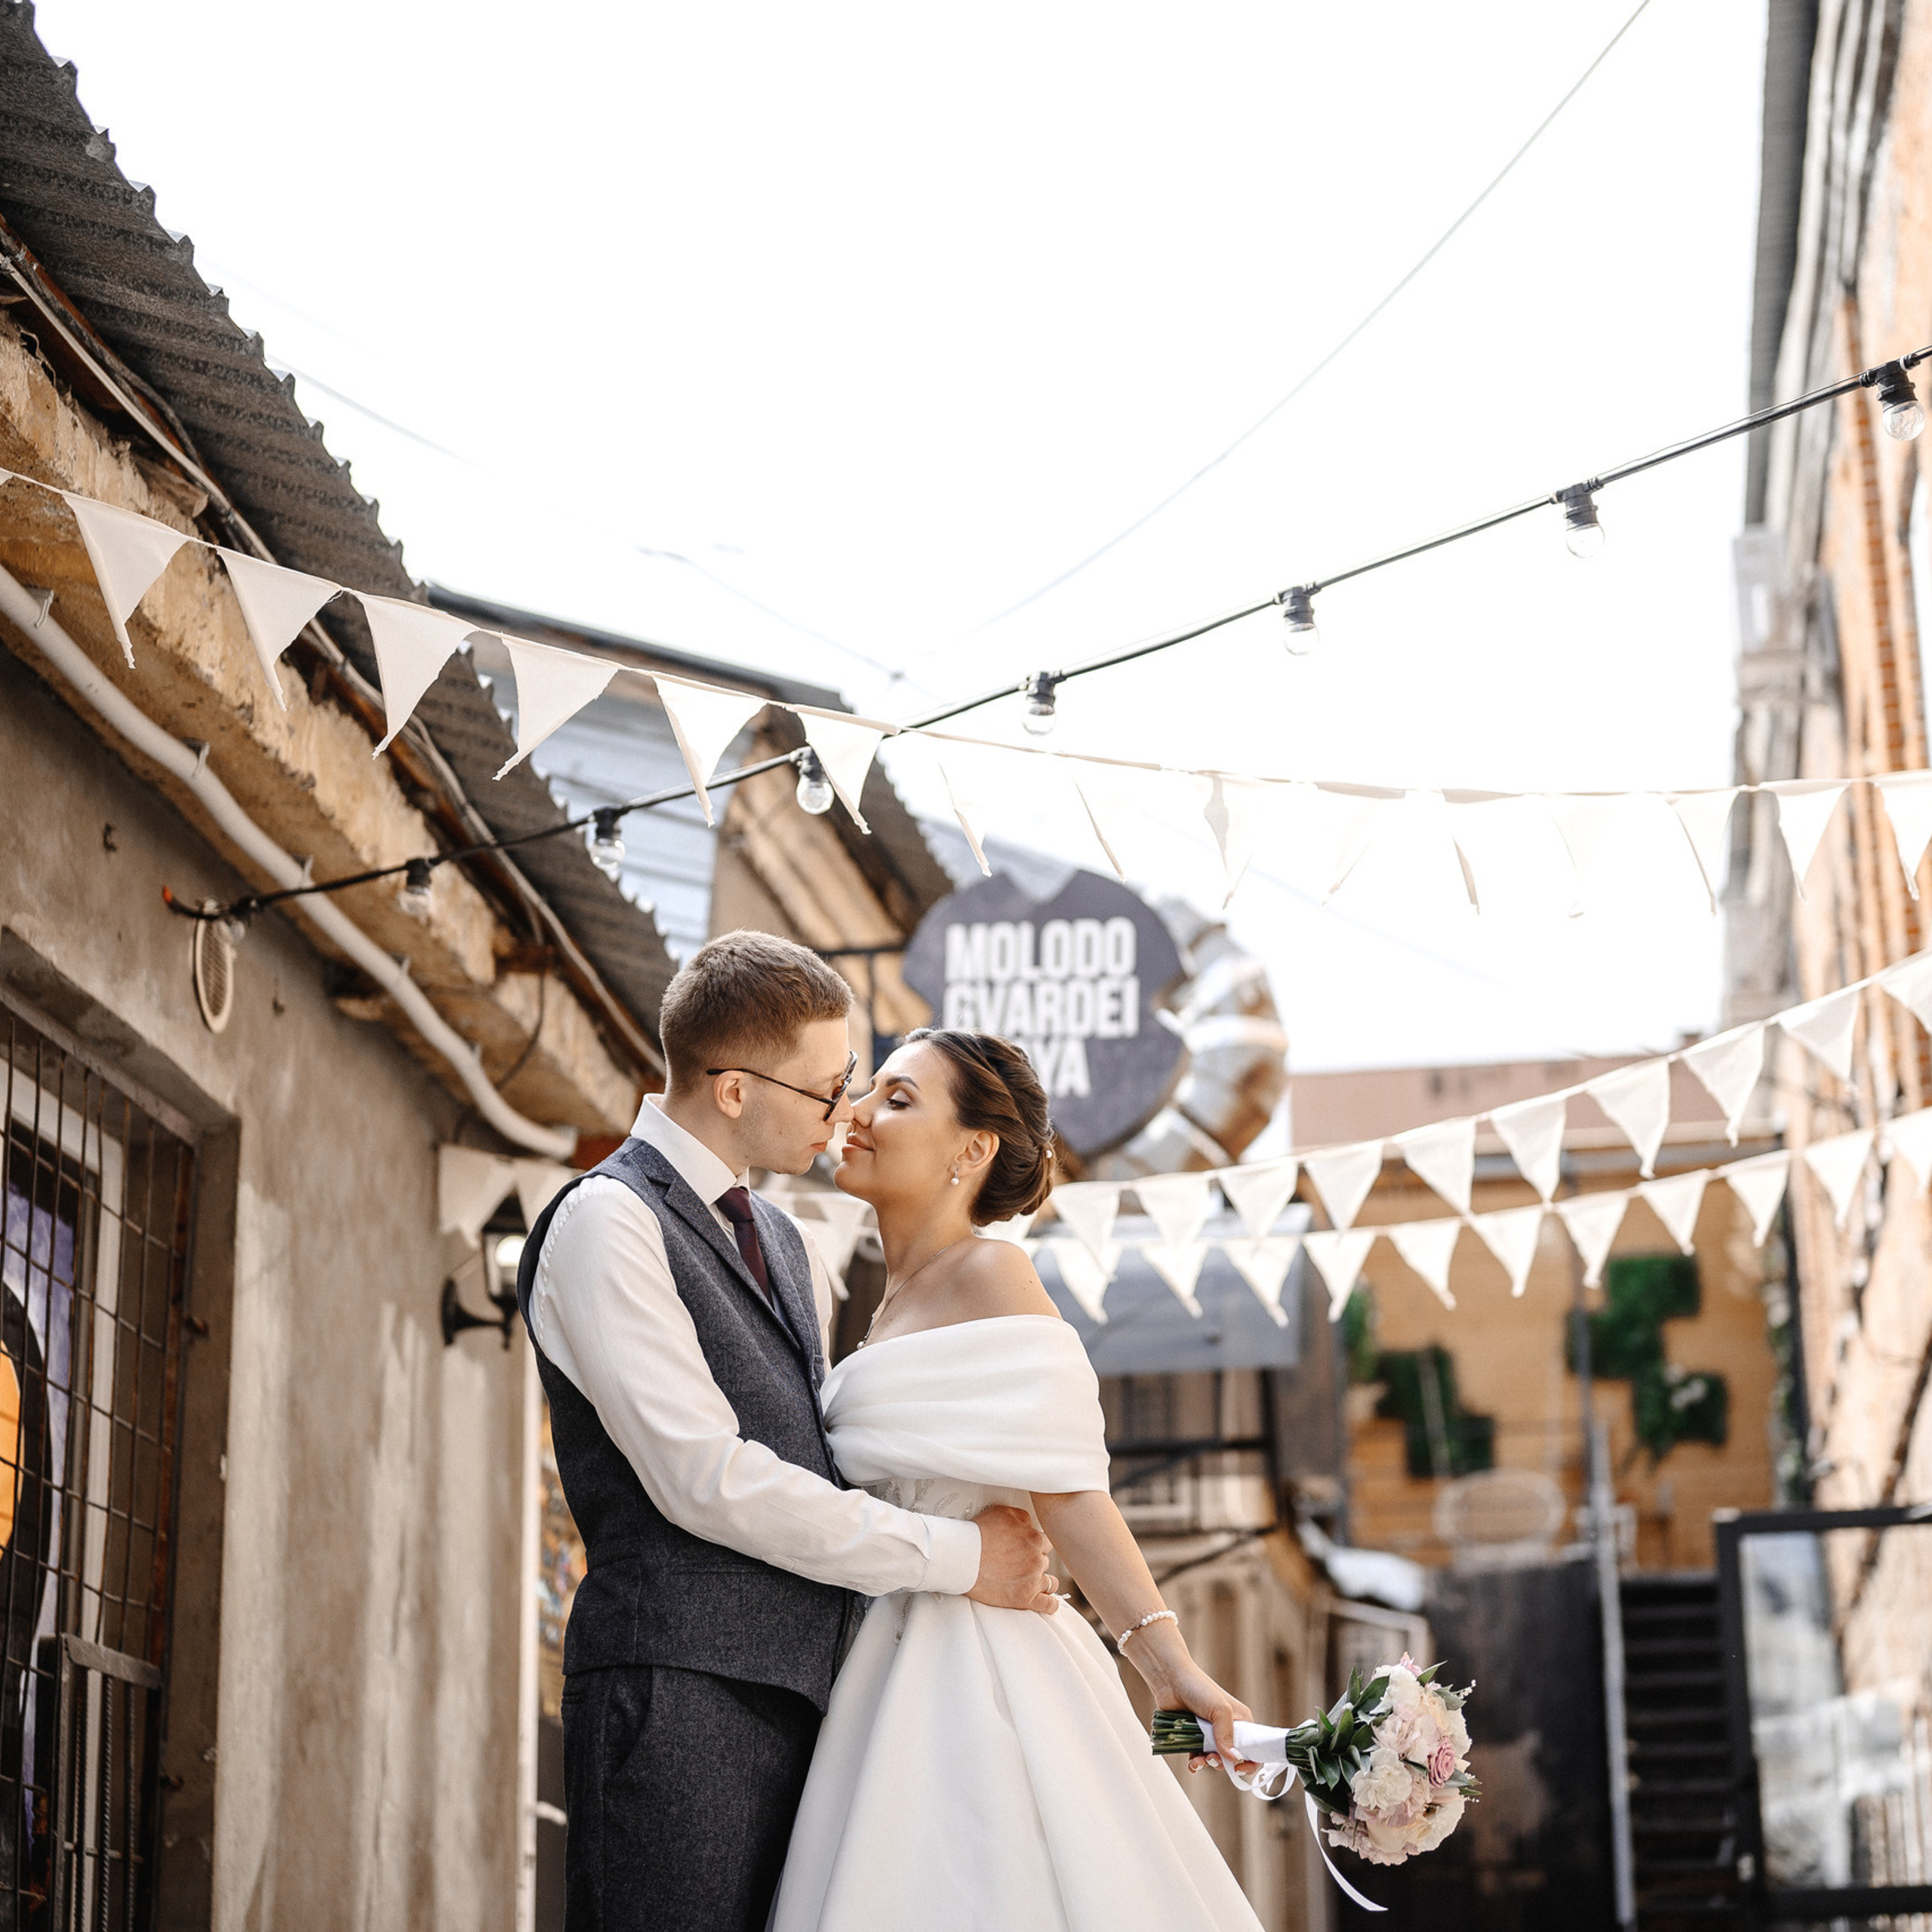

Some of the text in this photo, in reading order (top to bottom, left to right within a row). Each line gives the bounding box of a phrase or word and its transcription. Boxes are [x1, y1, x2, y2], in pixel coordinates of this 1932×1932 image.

[946, 916, 1137, 980] MOLODO
[943, 975, 1139, 1038] GVARDEI
[1016, 1038, 1091, 1097] YA
